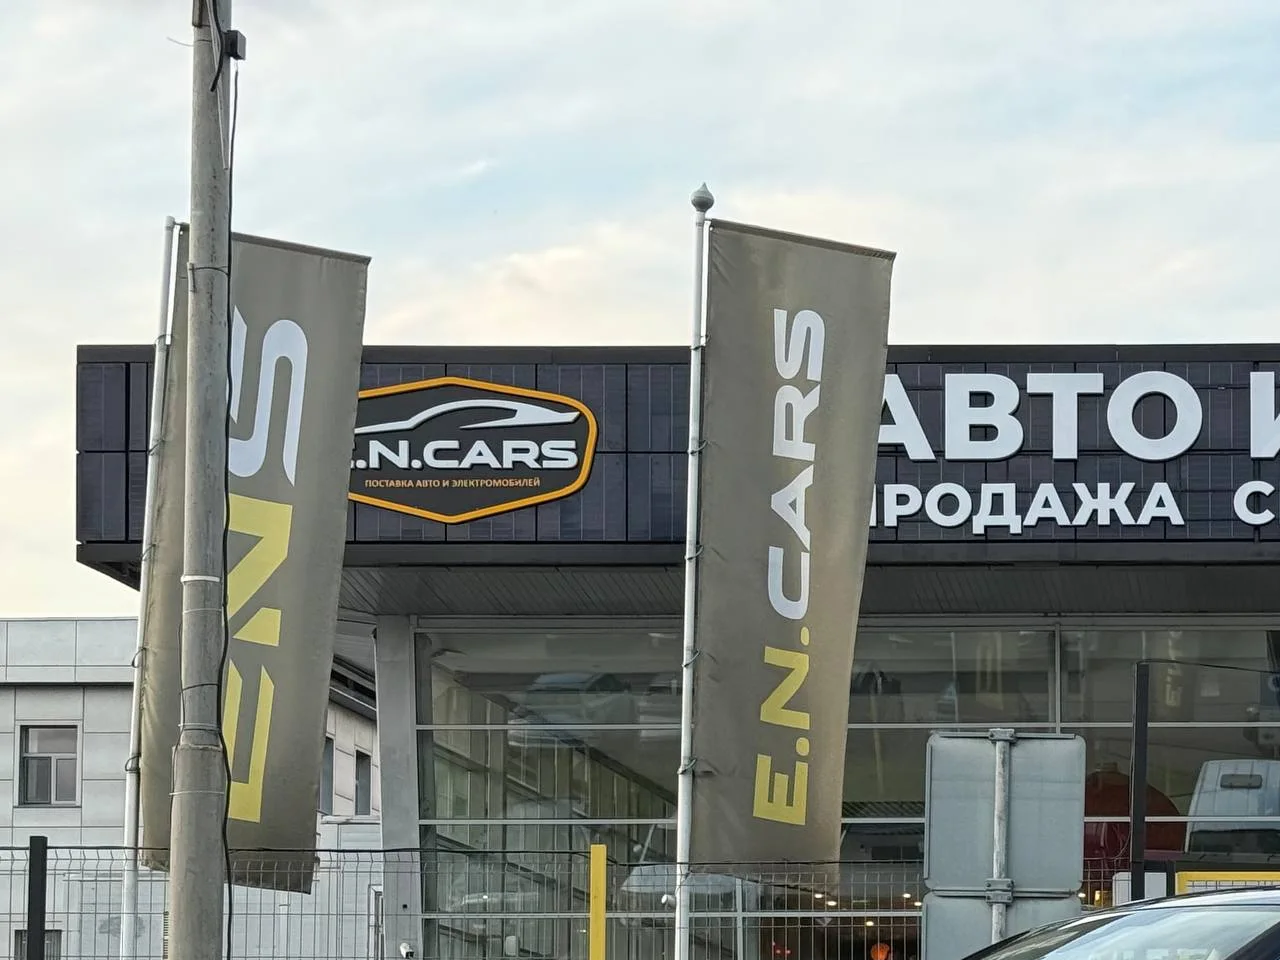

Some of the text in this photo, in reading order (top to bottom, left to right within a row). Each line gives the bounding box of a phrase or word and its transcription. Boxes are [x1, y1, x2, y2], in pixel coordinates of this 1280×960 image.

[878, 370, 1202, 461] АВТО
[350, 440, 578, 469] .N.CARS
[364, 477, 541, 488] ПОСТАВКА АВТО И ЭЛЕКТРОМОБИЛЕЙ
[753, 308, 826, 825] E.N.CARS
